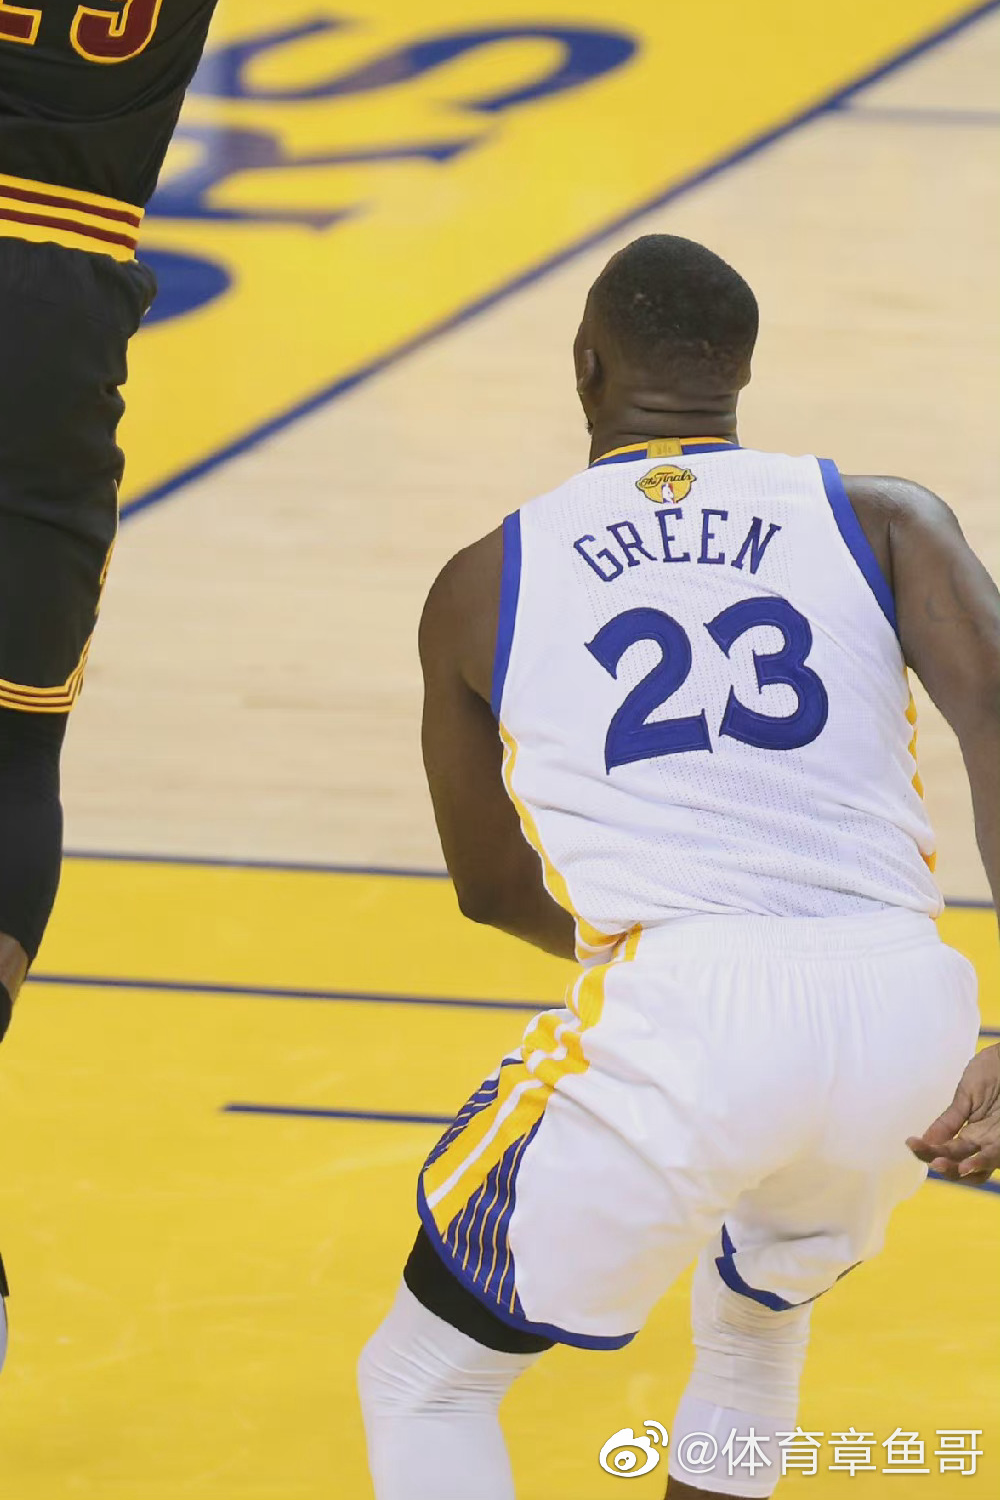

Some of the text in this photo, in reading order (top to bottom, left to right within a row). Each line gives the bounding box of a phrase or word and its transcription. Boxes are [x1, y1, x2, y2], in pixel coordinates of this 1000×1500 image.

[654, 469, 693, 486] Finals
[573, 507, 782, 583] GREEN
[584, 595, 830, 776] 23
